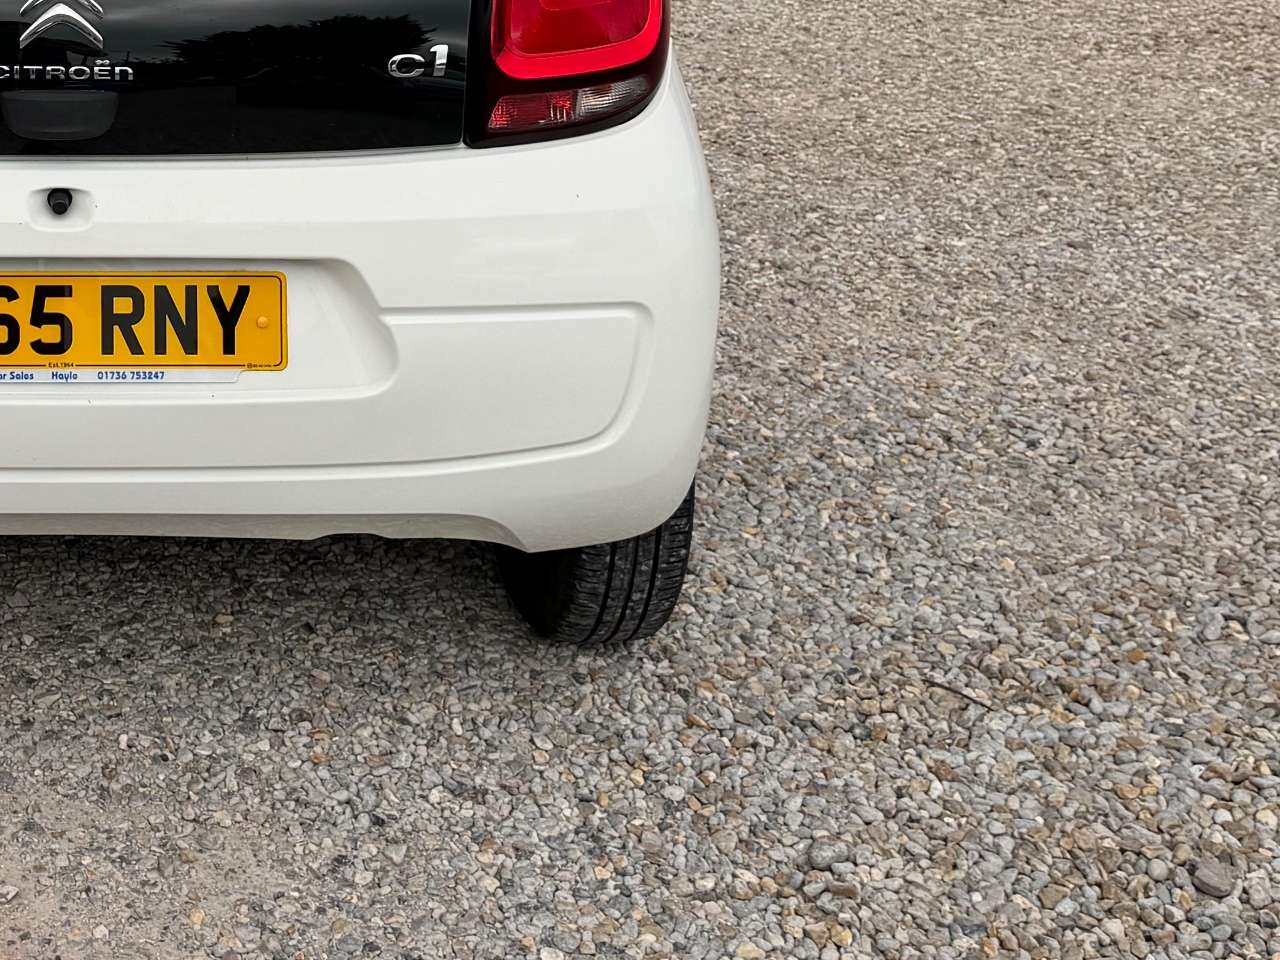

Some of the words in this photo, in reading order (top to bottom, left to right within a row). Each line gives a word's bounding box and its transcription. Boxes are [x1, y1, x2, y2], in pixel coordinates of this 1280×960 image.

[100, 284, 251, 356] RNY
[9, 371, 34, 380] Sales
[51, 371, 78, 382] Hayle
[97, 371, 127, 380] 01736
[129, 371, 165, 380] 753247
